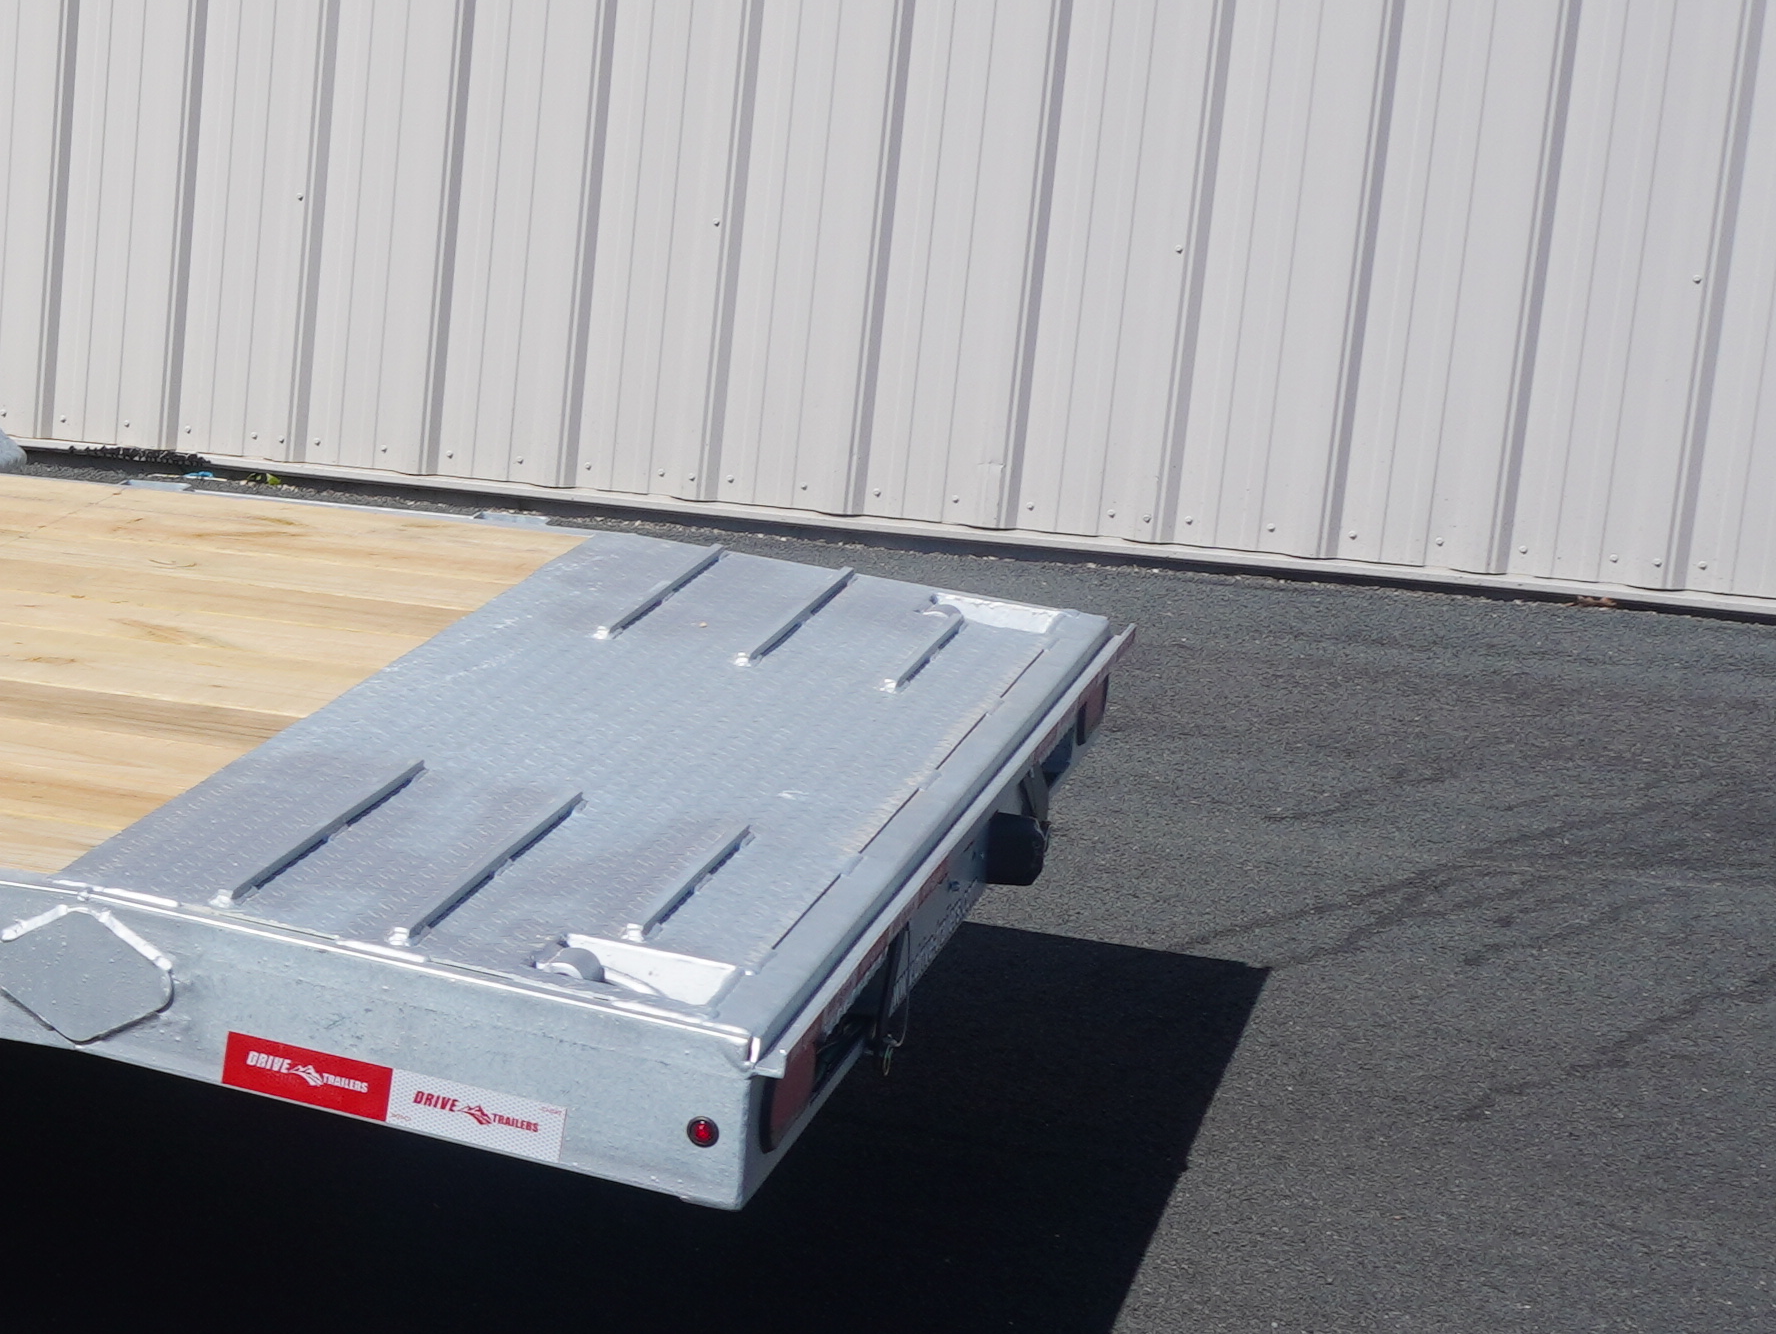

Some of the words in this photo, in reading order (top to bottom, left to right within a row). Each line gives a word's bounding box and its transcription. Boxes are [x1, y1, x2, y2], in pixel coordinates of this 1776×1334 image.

[246, 1050, 291, 1074] DRIVE
[322, 1071, 369, 1094] TRAILERS
[413, 1090, 459, 1113] DRIVE
[490, 1113, 539, 1134] TRAILERS
